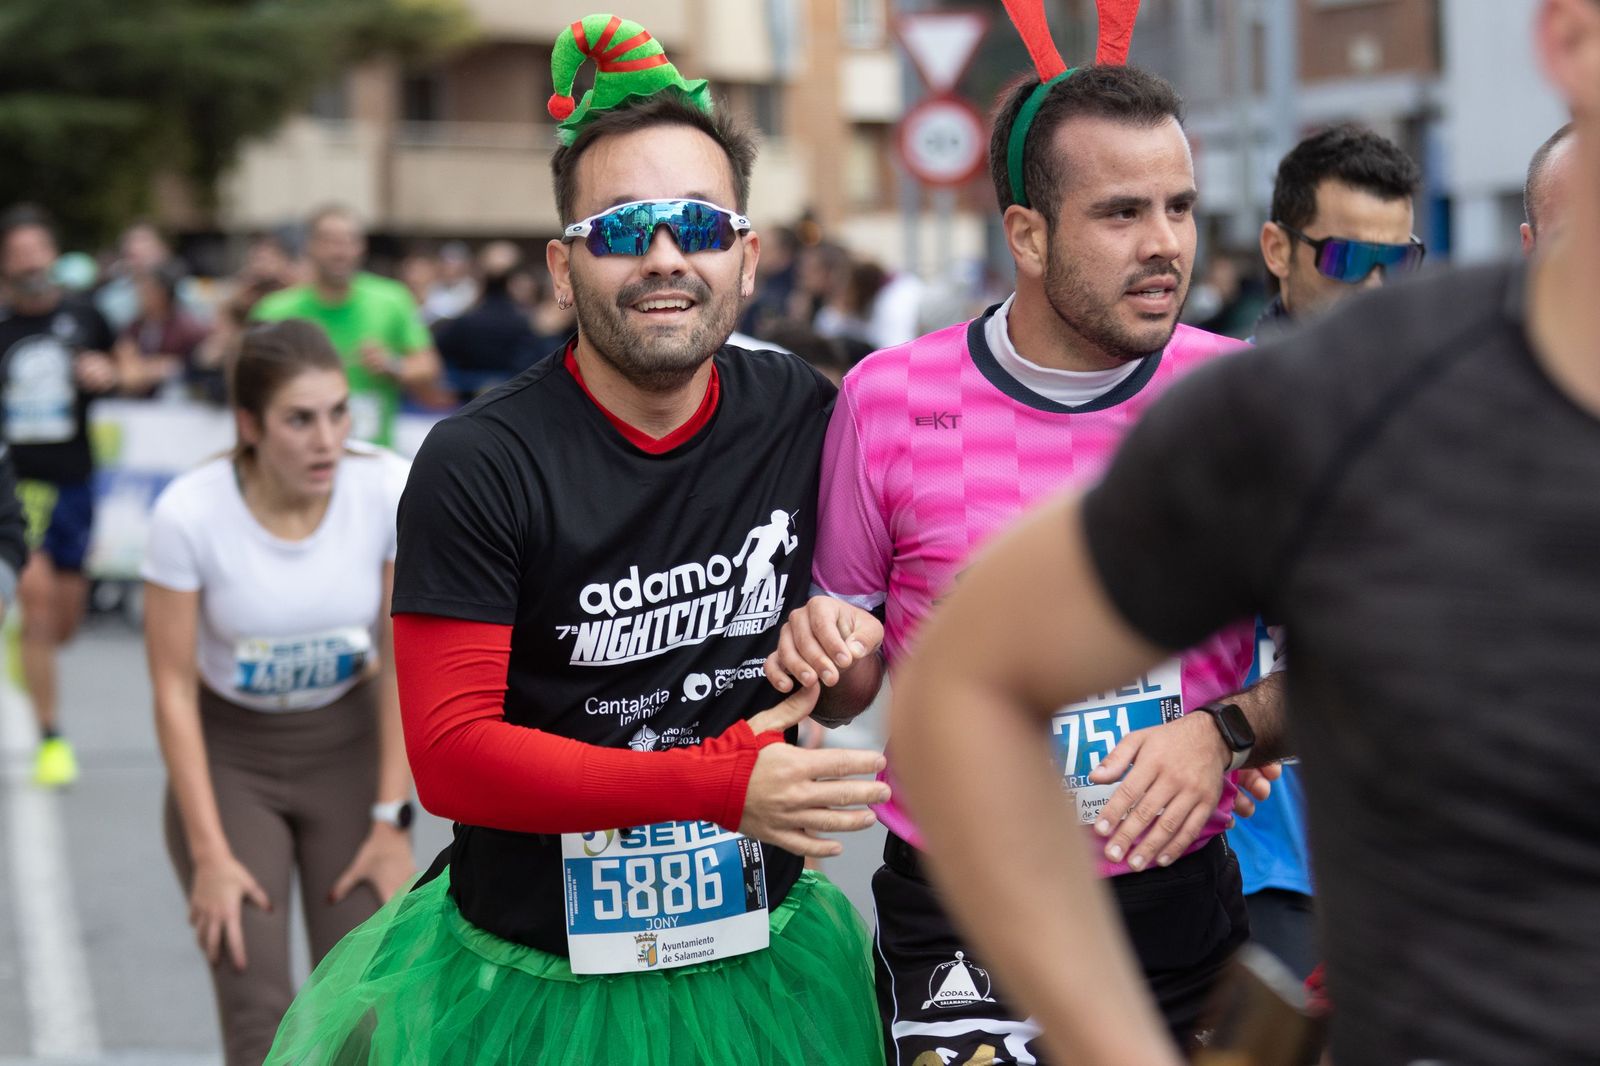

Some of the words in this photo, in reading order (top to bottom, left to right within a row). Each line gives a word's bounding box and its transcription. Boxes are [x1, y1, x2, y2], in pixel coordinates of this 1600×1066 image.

[915, 411, 962, 430] EKT
[579, 554, 732, 617] adamo
[585, 688, 670, 715] Cantabria
[1052, 707, 1130, 775] 751
[752, 842, 760, 863] 5886
[591, 847, 723, 920] 5886
[646, 915, 680, 931] JONY
[661, 936, 715, 951] Ayuntamiento
[662, 953, 673, 963] de
[674, 947, 715, 962] Salamanca
